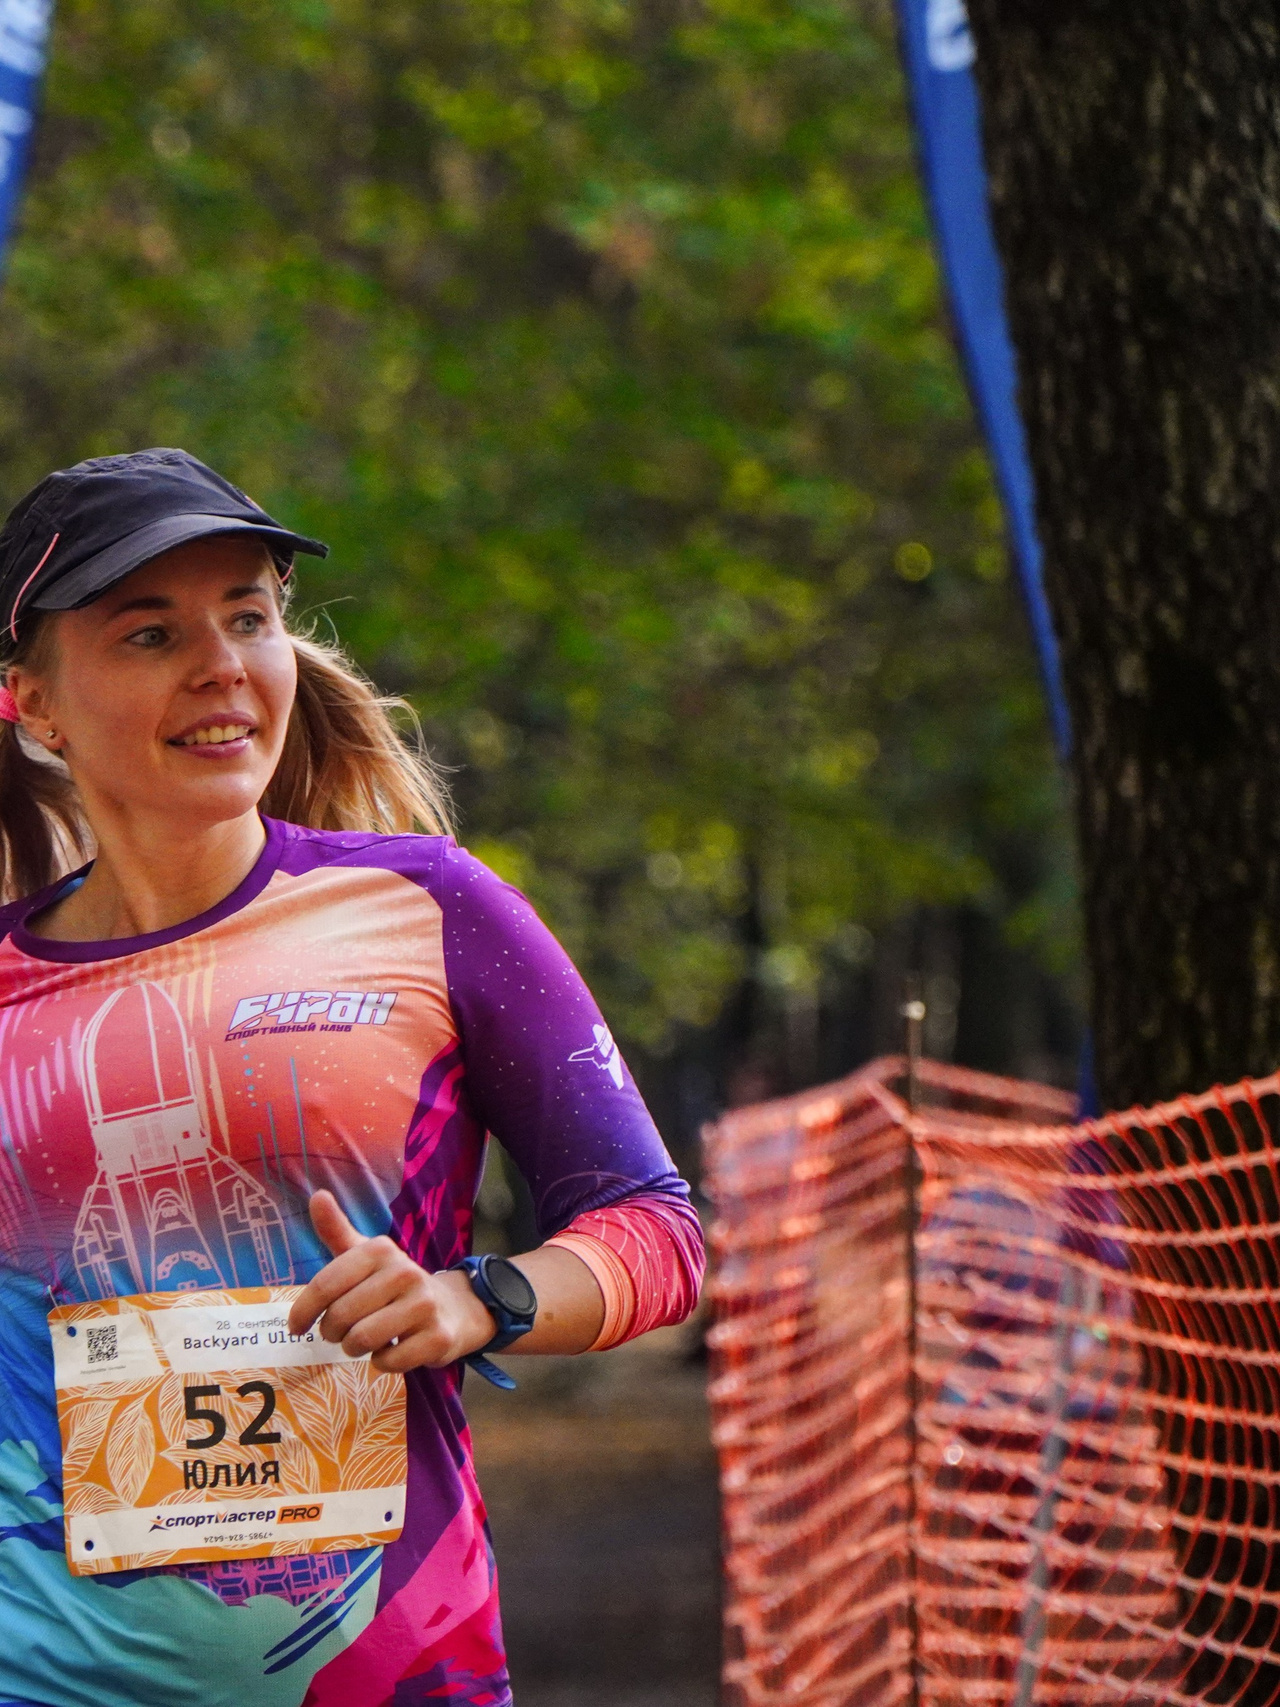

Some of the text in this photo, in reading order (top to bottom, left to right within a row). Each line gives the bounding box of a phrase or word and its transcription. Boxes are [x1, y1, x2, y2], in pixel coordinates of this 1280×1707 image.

[224, 1022, 353, 1042] СПОРТИВНЫЙ КЛУБ
[215, 1317, 289, 1331] 28 сентябр
[183, 1332, 259, 1350] Backyard
[268, 1330, 314, 1345] Ultra
[183, 1380, 282, 1451] 52
[182, 1459, 281, 1491] Юлия
[280, 1506, 320, 1522] PRO
